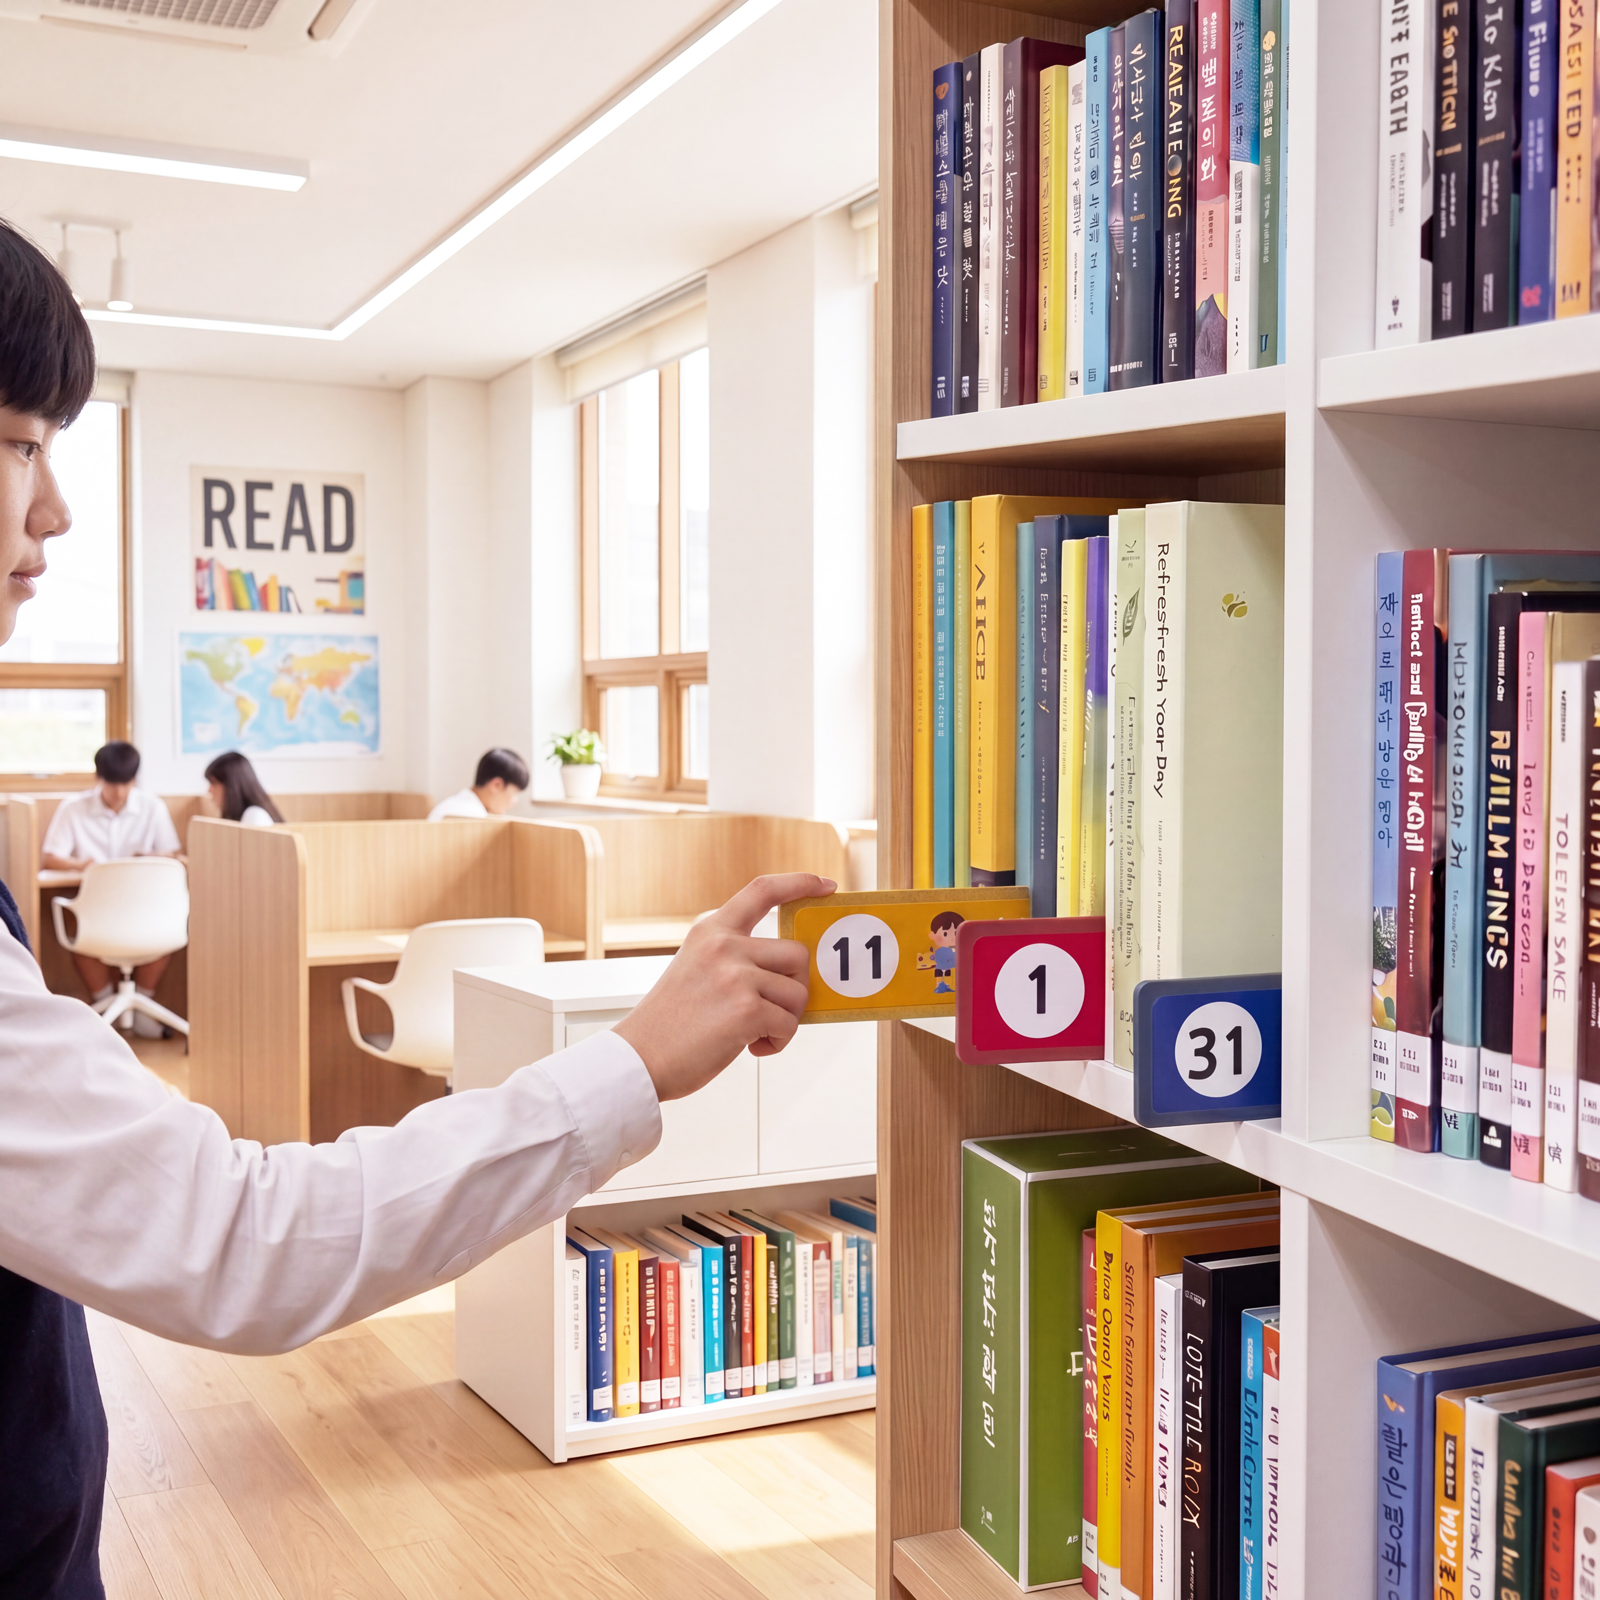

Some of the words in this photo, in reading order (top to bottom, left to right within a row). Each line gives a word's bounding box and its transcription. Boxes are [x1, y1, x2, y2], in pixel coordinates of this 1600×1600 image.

[202, 477, 355, 553] READ
[1153, 756, 1167, 799] Day
[831, 935, 882, 982] 11
[1027, 964, 1047, 1015] 1
[1188, 1025, 1243, 1080] 31
